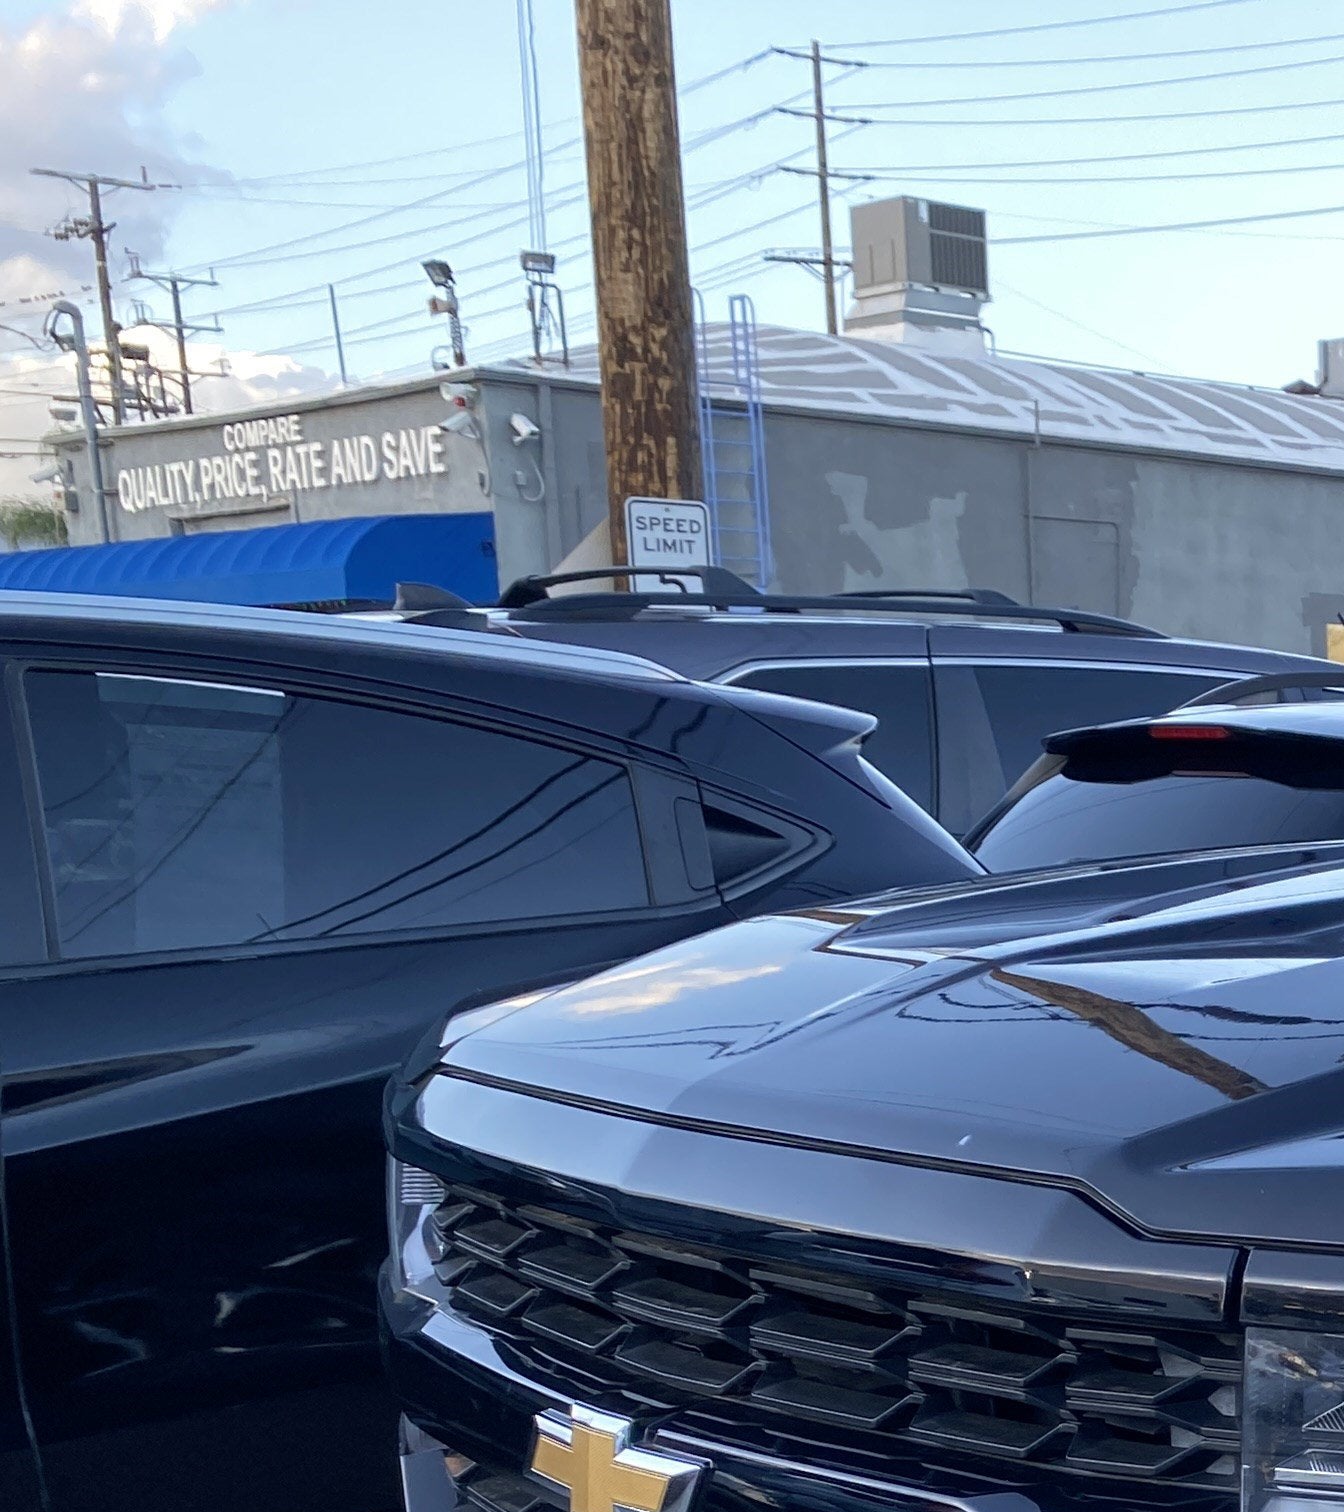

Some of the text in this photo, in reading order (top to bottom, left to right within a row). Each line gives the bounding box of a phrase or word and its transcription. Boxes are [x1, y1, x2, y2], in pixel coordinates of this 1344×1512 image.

[222, 414, 303, 451] COMPARE
[118, 426, 445, 513] QUALITY, PRICE, RATE AND SAVE
[635, 515, 702, 534] SPEED
[643, 536, 696, 554] LIMIT
